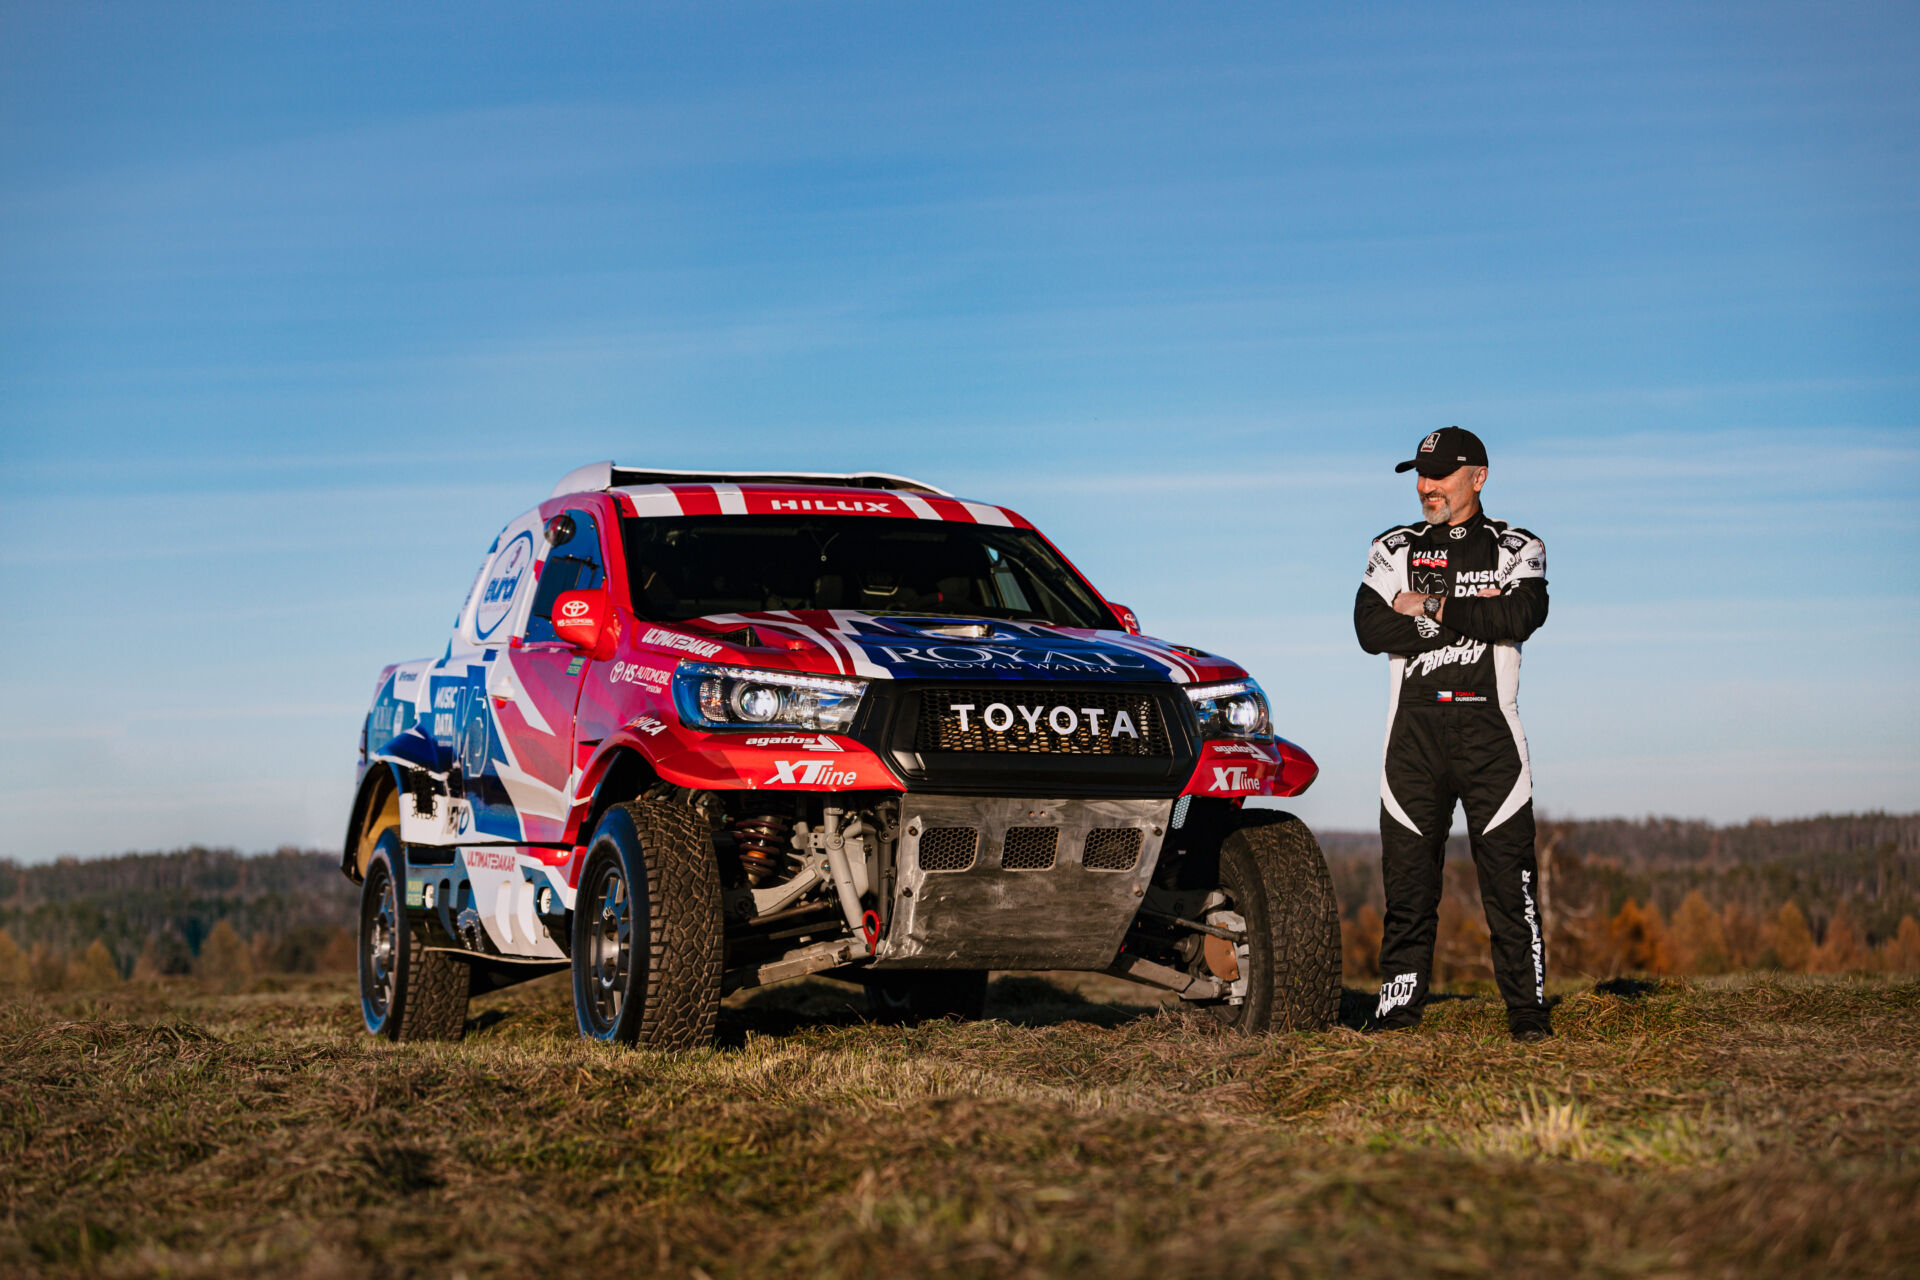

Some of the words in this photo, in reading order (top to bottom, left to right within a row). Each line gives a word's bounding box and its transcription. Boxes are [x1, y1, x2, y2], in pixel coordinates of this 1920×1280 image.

[771, 499, 892, 514] HILUX
[1456, 570, 1501, 584] MUSIC
[880, 645, 1145, 669] ROYAL
[936, 661, 1022, 671] ROYAL
[1027, 662, 1118, 674] WATER
[622, 663, 638, 682] HS
[635, 665, 672, 686] AUTOMOBIL
[950, 702, 1140, 739] TOYOTA
[745, 736, 817, 747] agados
[763, 760, 857, 785] XTline
[1208, 767, 1260, 791] XTline
[1381, 982, 1415, 1002] HOT
